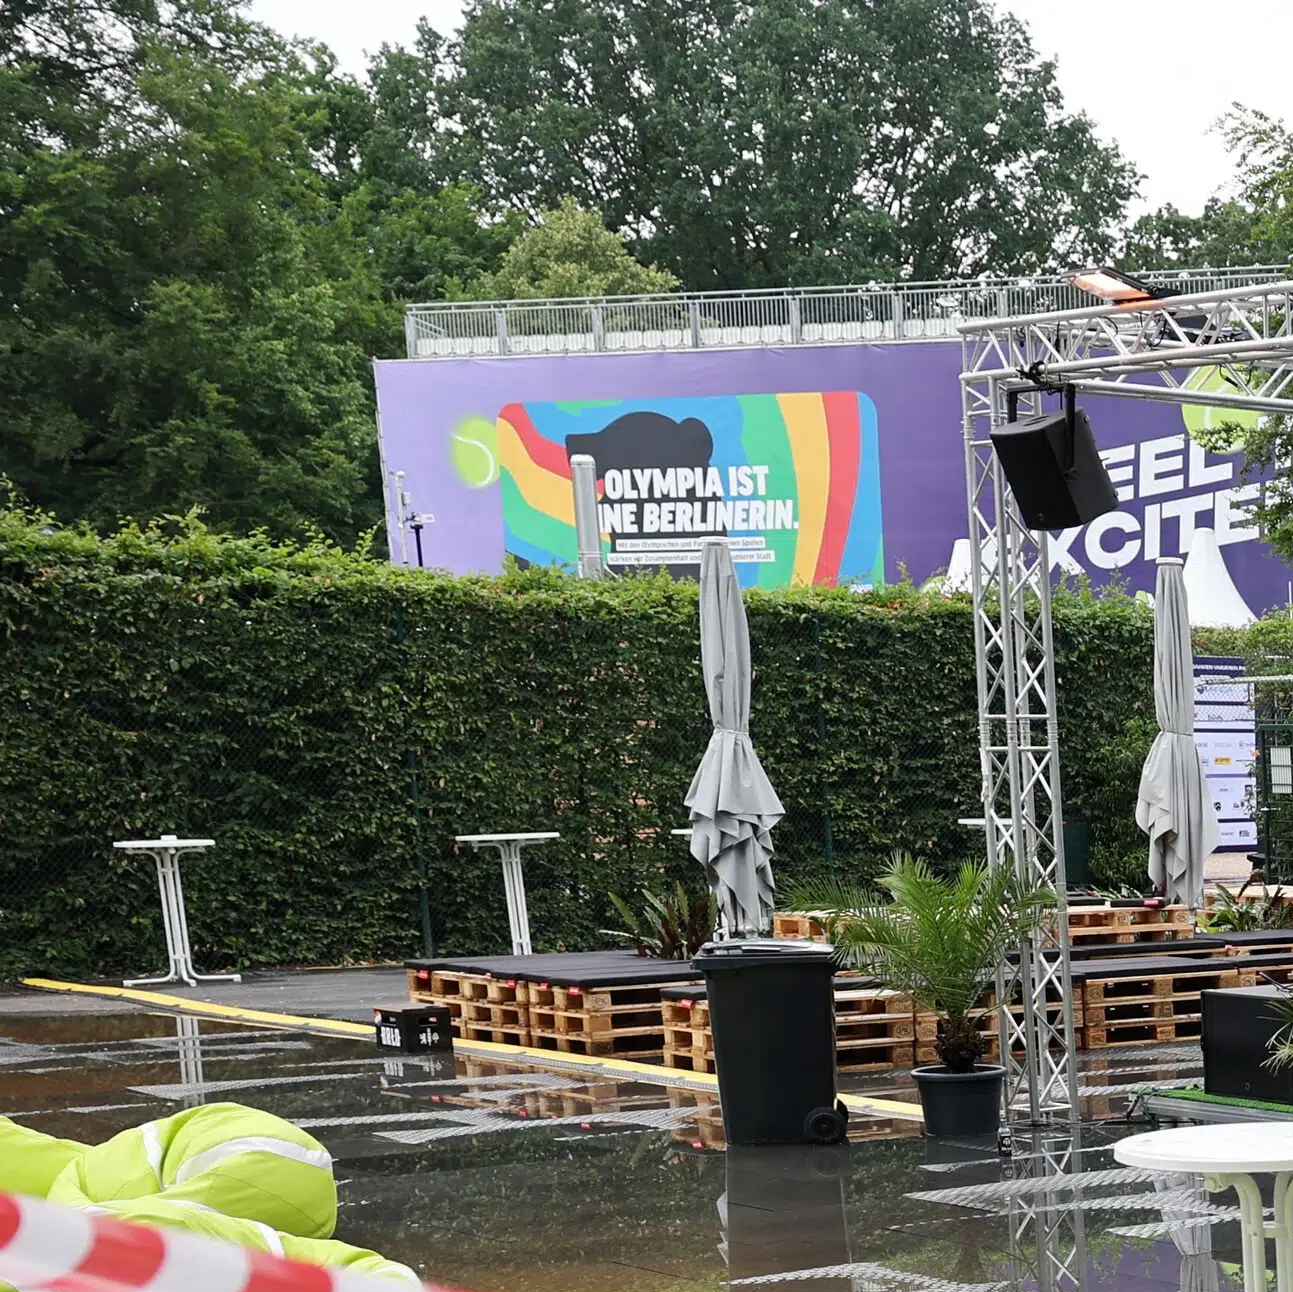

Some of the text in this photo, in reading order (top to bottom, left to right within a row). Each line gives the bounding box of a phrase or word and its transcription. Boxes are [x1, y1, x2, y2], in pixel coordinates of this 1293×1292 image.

[604, 465, 770, 500] OLYMPIA IST
[1098, 433, 1233, 503] EEL
[598, 499, 800, 534] INE BERLINERIN.
